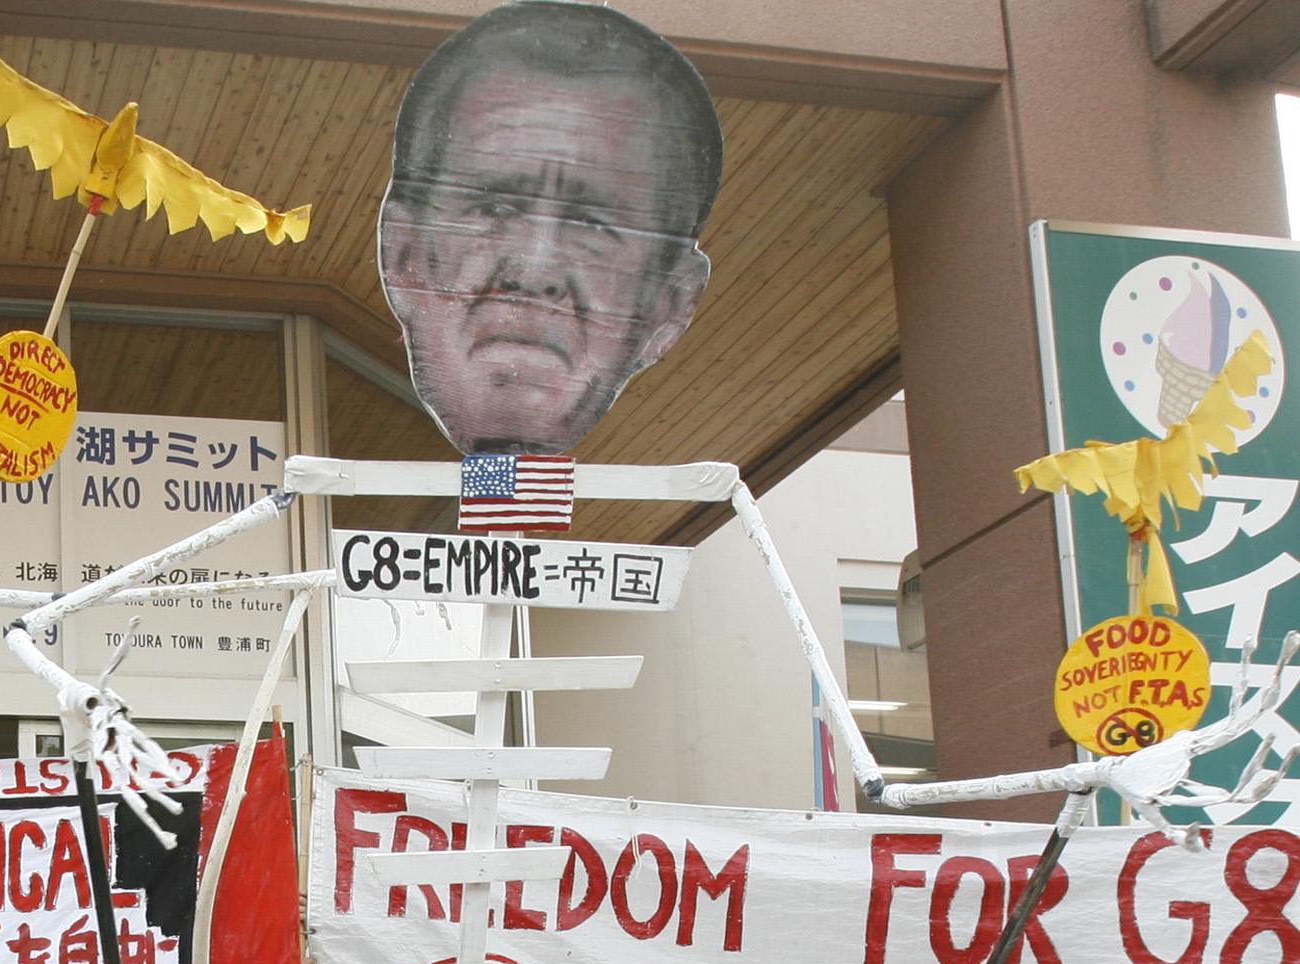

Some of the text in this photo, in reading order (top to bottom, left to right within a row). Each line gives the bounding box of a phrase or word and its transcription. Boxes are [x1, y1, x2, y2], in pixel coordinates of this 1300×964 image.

[10, 340, 66, 374] DIRECT
[0, 395, 41, 430] NOT
[190, 598, 204, 609] to
[212, 598, 233, 610] the
[241, 599, 283, 612] future
[171, 635, 204, 650] TOWN
[217, 636, 271, 653] 豊浦町
[1085, 619, 1171, 657] FOOD
[1073, 685, 1121, 718] NOT
[1105, 720, 1156, 748] G8
